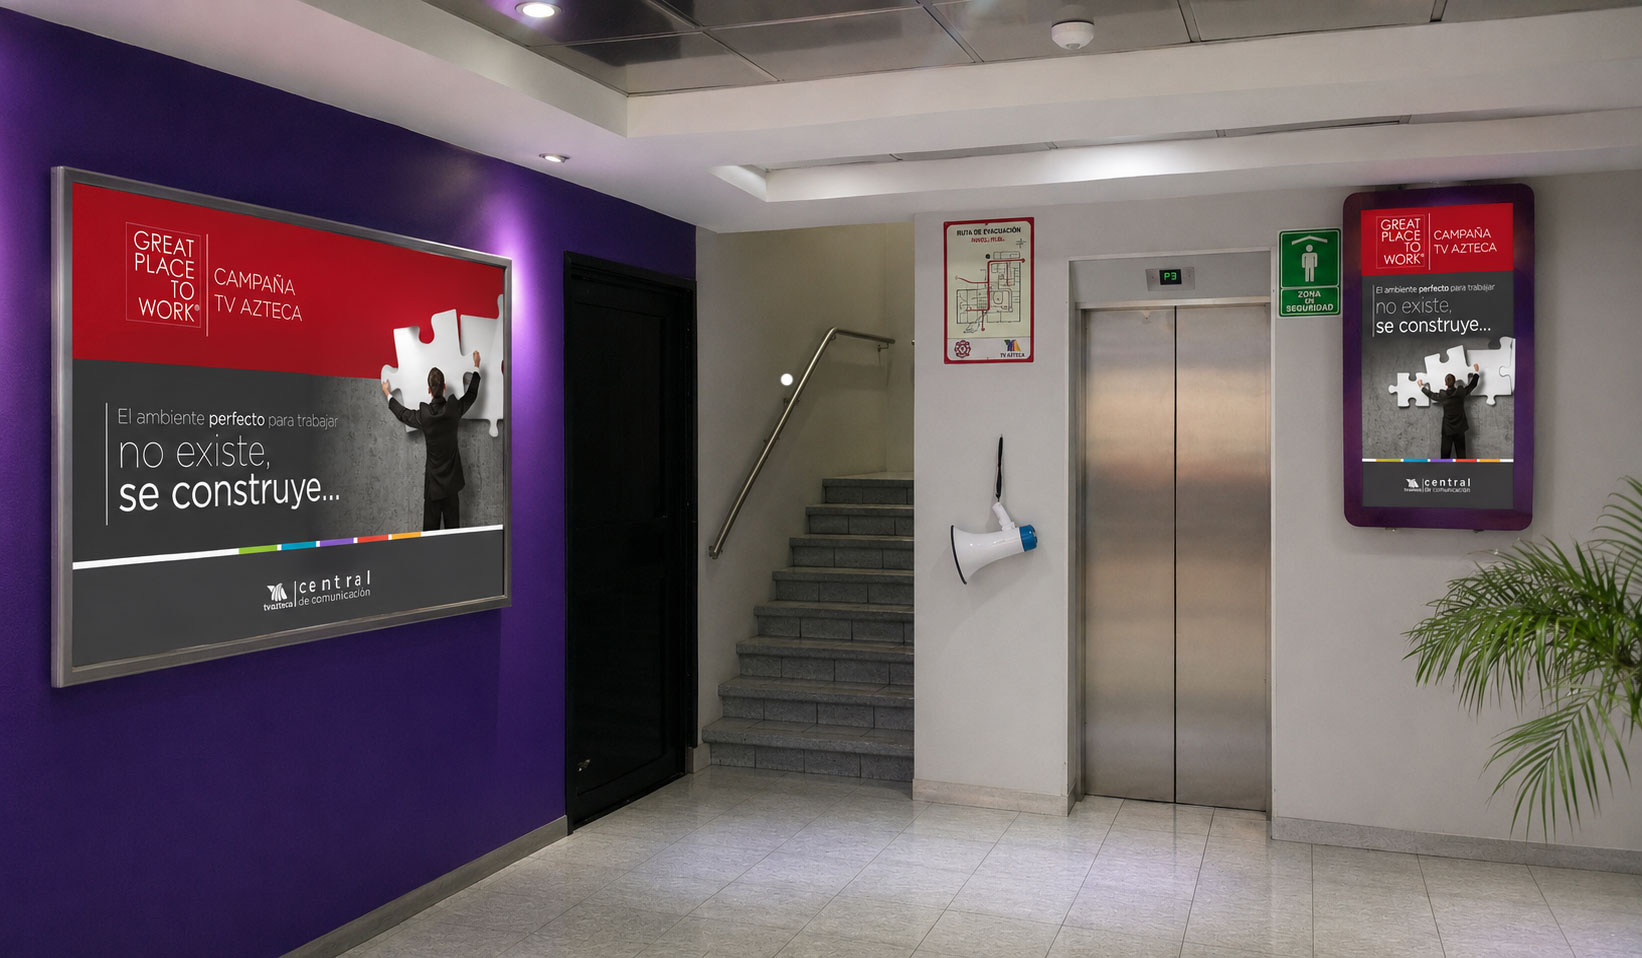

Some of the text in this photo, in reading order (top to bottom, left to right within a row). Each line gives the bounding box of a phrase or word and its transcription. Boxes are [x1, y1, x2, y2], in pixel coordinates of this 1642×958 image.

[1380, 218, 1421, 230] GREAT
[1433, 226, 1491, 240] CAMPAÑA
[133, 230, 194, 257] GREAT
[1381, 230, 1421, 242] PLACE
[1404, 242, 1421, 253] TO
[1434, 242, 1497, 254] TV AZTECA
[135, 252, 194, 279] PLACE
[214, 267, 296, 296] CAMPAÑA
[1163, 272, 1177, 281] P3
[171, 280, 194, 300] TO
[1297, 290, 1321, 298] ZONA
[1384, 286, 1417, 294] ambiente
[1419, 284, 1449, 294] perfecto
[1468, 284, 1495, 292] trabajar
[214, 294, 302, 321] TV AZTECA
[1286, 304, 1334, 313] SEGURIDAD
[1376, 297, 1452, 315] no existe,
[1376, 317, 1491, 335] se construye...
[118, 408, 338, 430] El ambiente perfecto para trabajar
[119, 434, 270, 469] no existe,
[1424, 478, 1471, 487] central
[119, 473, 340, 512] se construye...
[299, 570, 370, 594] central
[298, 587, 371, 606] de comunicación
